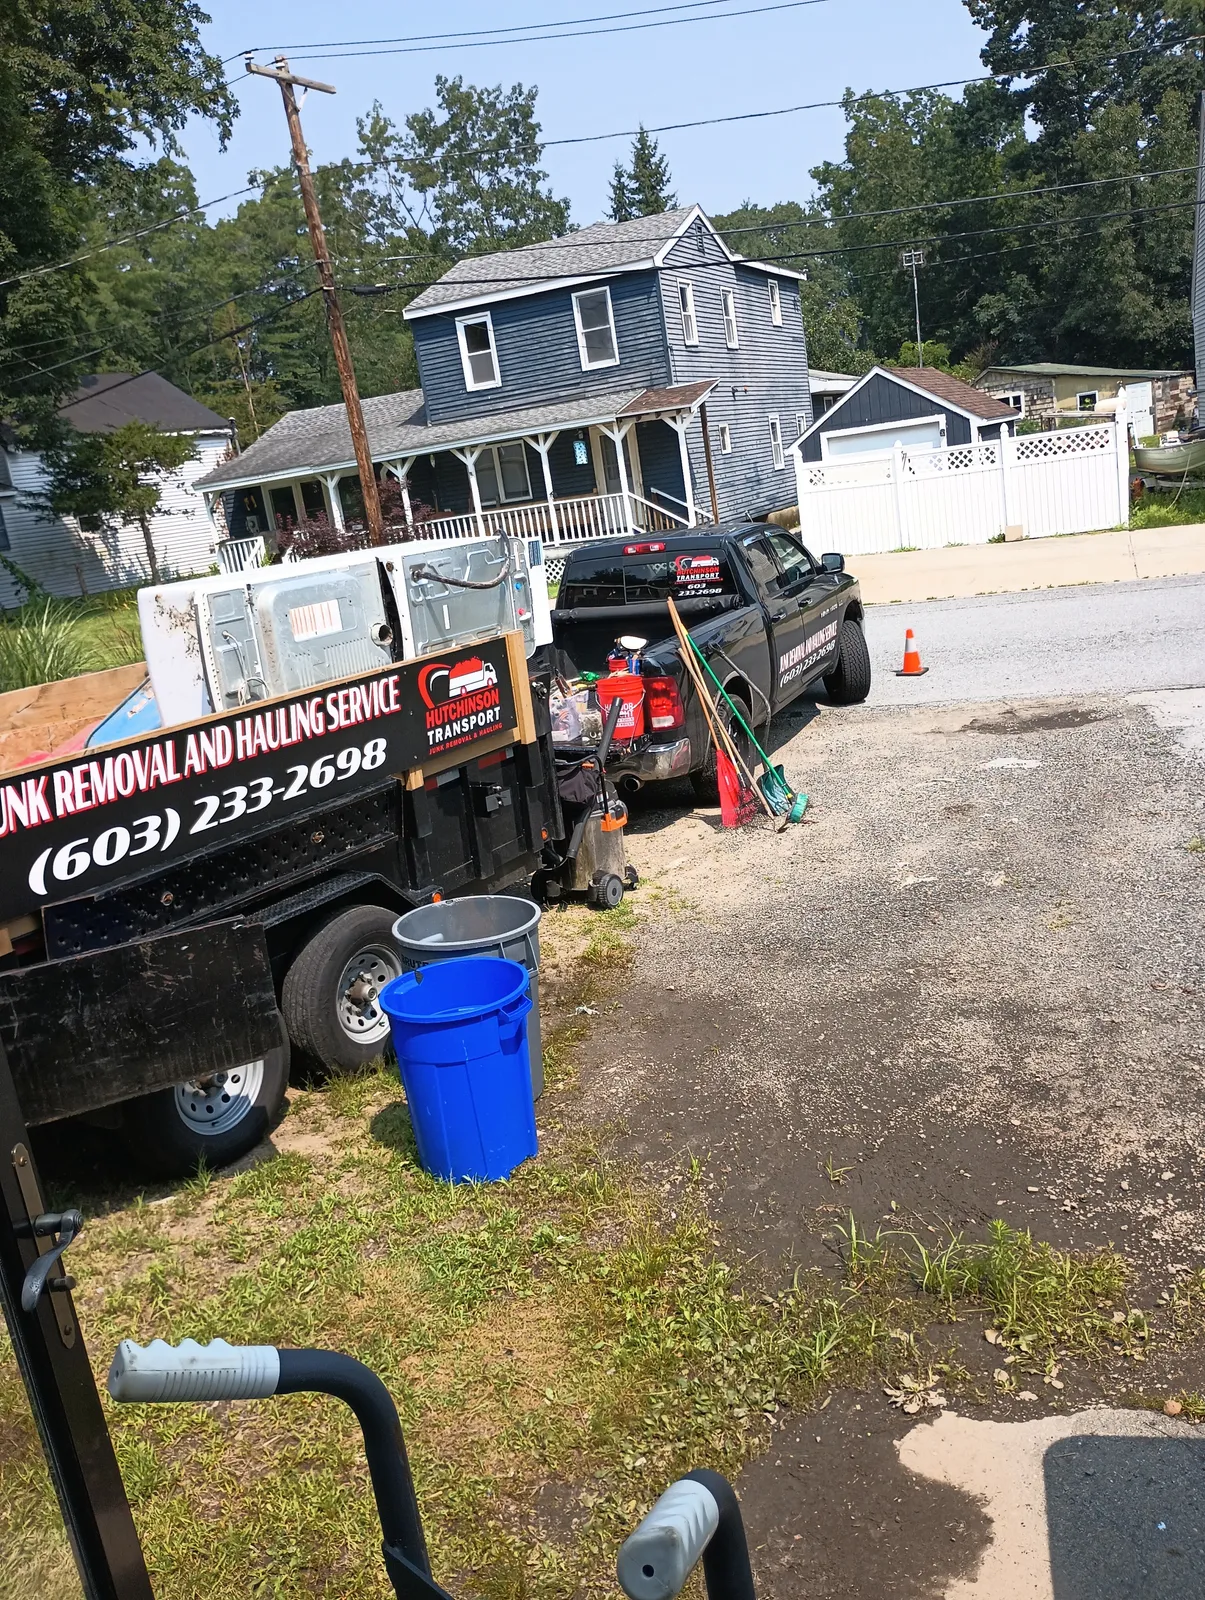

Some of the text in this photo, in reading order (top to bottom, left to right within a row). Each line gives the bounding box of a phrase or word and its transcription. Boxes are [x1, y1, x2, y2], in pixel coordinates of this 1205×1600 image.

[676, 567, 719, 575] HUTCHINSON
[676, 572, 720, 581] TRANSPORT
[678, 588, 722, 596] 233-2698
[780, 640, 836, 688] (603) 233-2698
[425, 688, 499, 729] HUTCHINSON
[427, 706, 500, 745] TRANSPORT
[53, 740, 182, 818] REMOVAL
[185, 725, 234, 778] AND
[235, 697, 325, 761] HAULING
[326, 675, 401, 731] SERVICE
[429, 745, 444, 755] JUNK
[445, 734, 472, 749] REMOVAL
[479, 723, 503, 736] HAULING
[28, 738, 388, 895] (603) 233-2698
